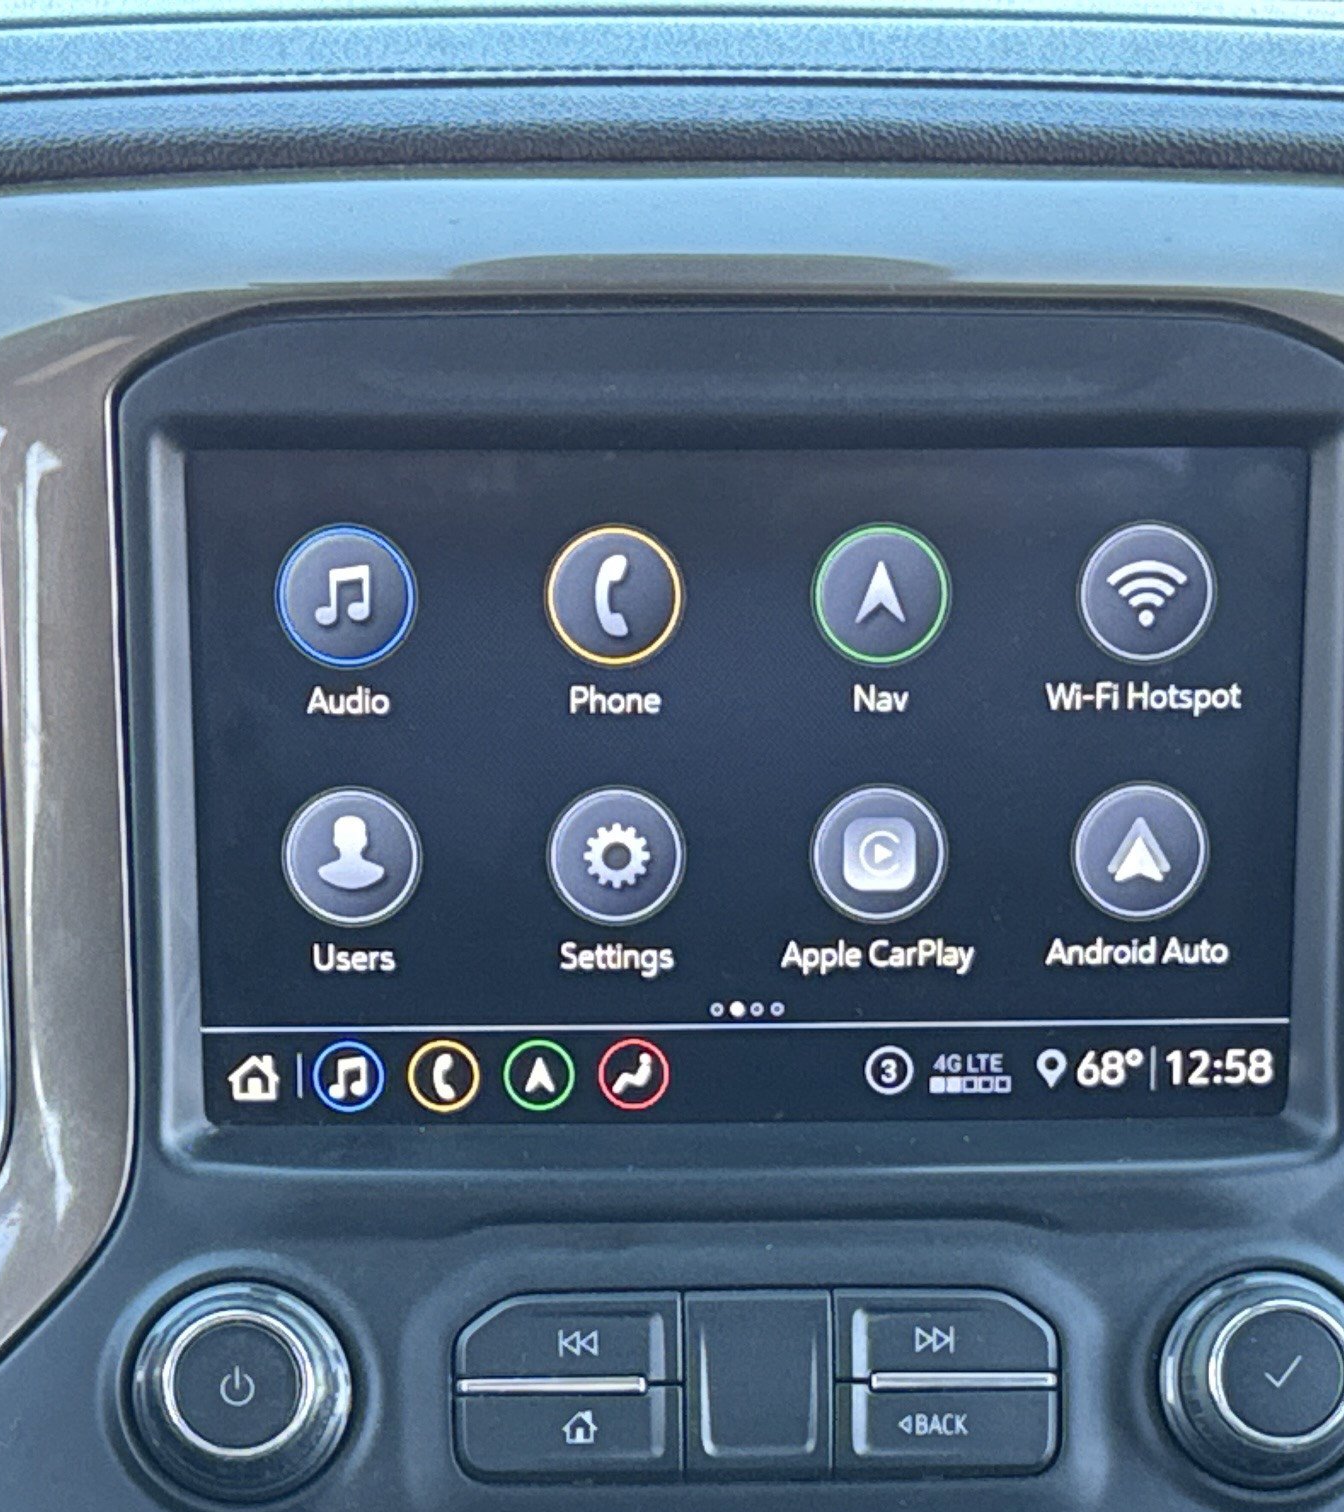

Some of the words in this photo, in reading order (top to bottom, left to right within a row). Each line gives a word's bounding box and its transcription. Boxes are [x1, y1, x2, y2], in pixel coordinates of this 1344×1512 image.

[307, 687, 390, 715] Audio
[569, 686, 661, 714] Phone
[853, 685, 909, 712] Nav
[1046, 683, 1120, 710] Wi-Fi
[1127, 681, 1241, 716] Hotspot
[313, 944, 395, 972] Users
[560, 943, 674, 977] Settings
[782, 942, 861, 974] Apple
[869, 941, 974, 974] CarPlay
[1046, 938, 1156, 967] Android
[1162, 937, 1228, 965] Auto
[881, 1059, 897, 1081] 3
[933, 1056, 963, 1073] 4G
[967, 1054, 1004, 1072] LTE
[1167, 1049, 1273, 1085] 12:58
[915, 1413, 968, 1436] BACK
